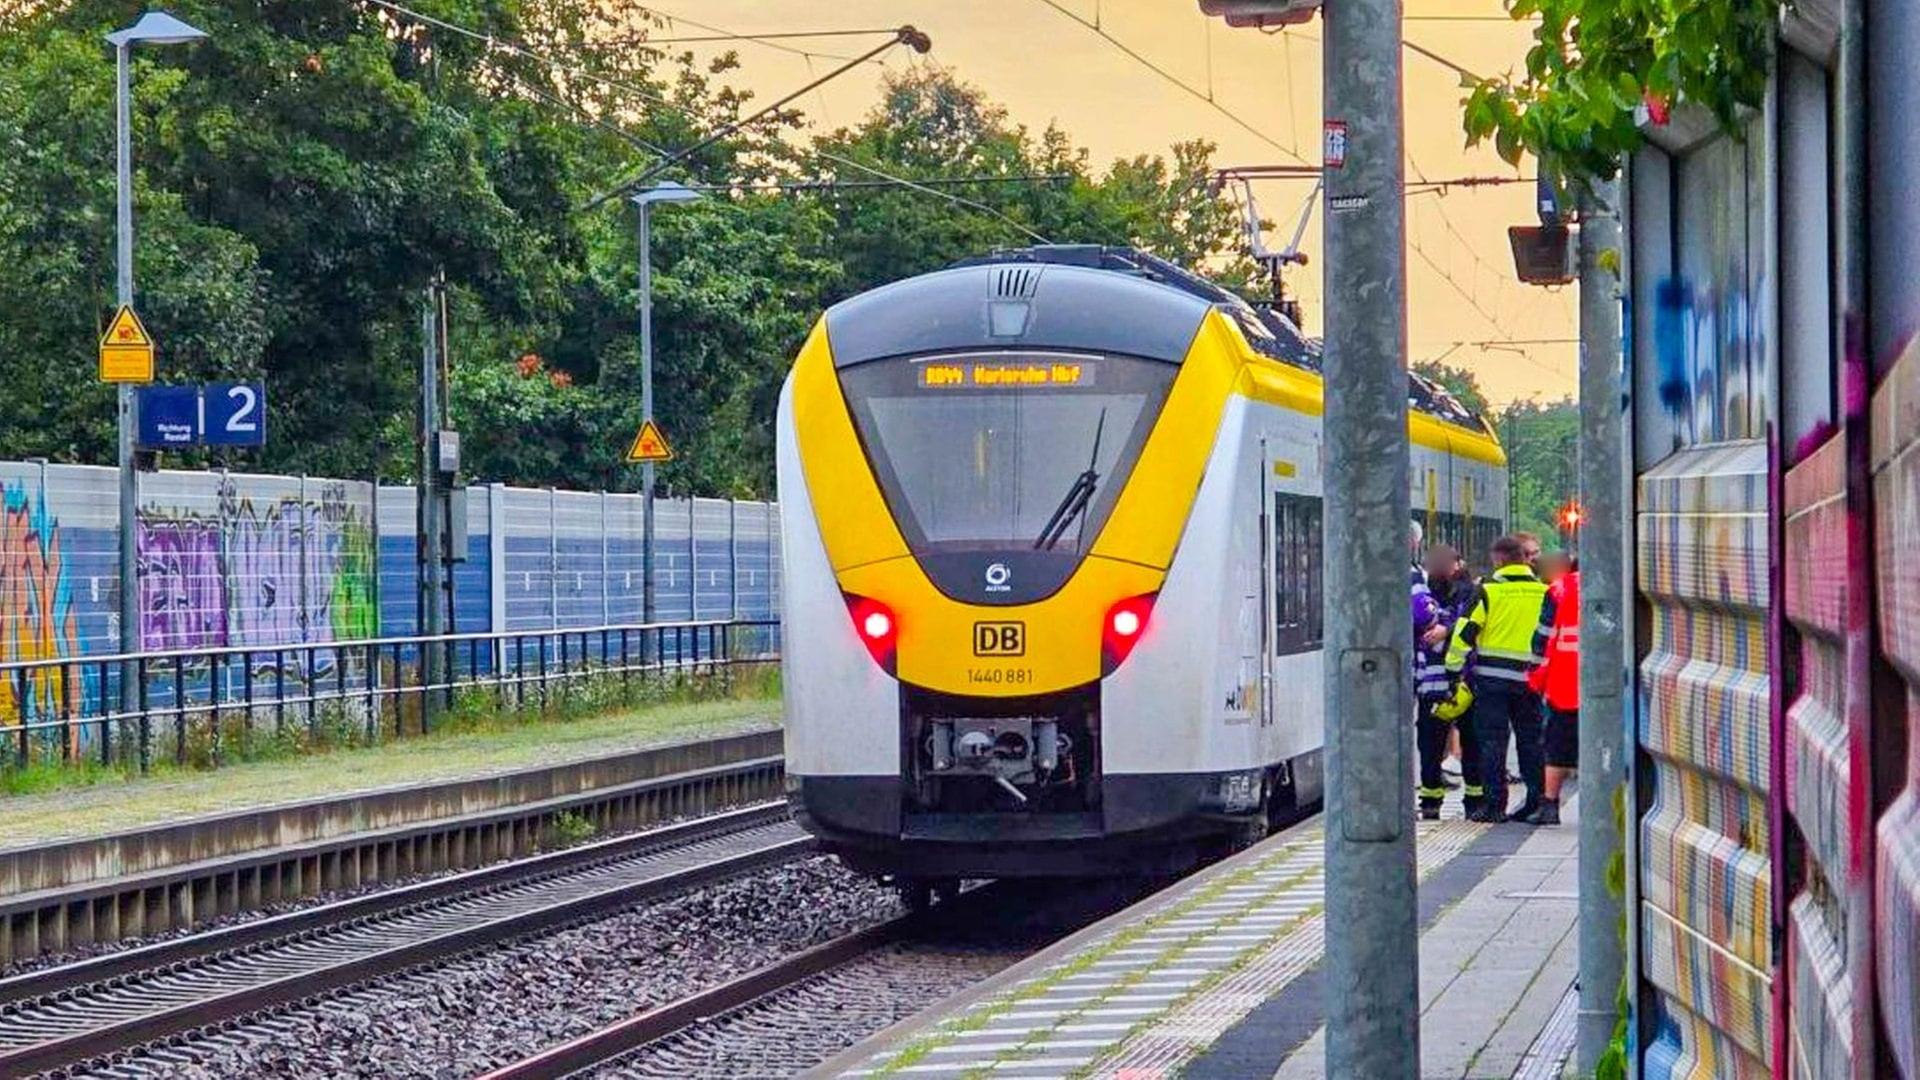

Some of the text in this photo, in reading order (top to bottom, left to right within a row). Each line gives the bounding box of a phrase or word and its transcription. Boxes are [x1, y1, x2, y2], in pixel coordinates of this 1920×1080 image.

[1052, 365, 1081, 383] Hbf
[226, 386, 256, 431] 2
[978, 625, 1021, 653] DB
[967, 669, 1033, 684] 1440 881
